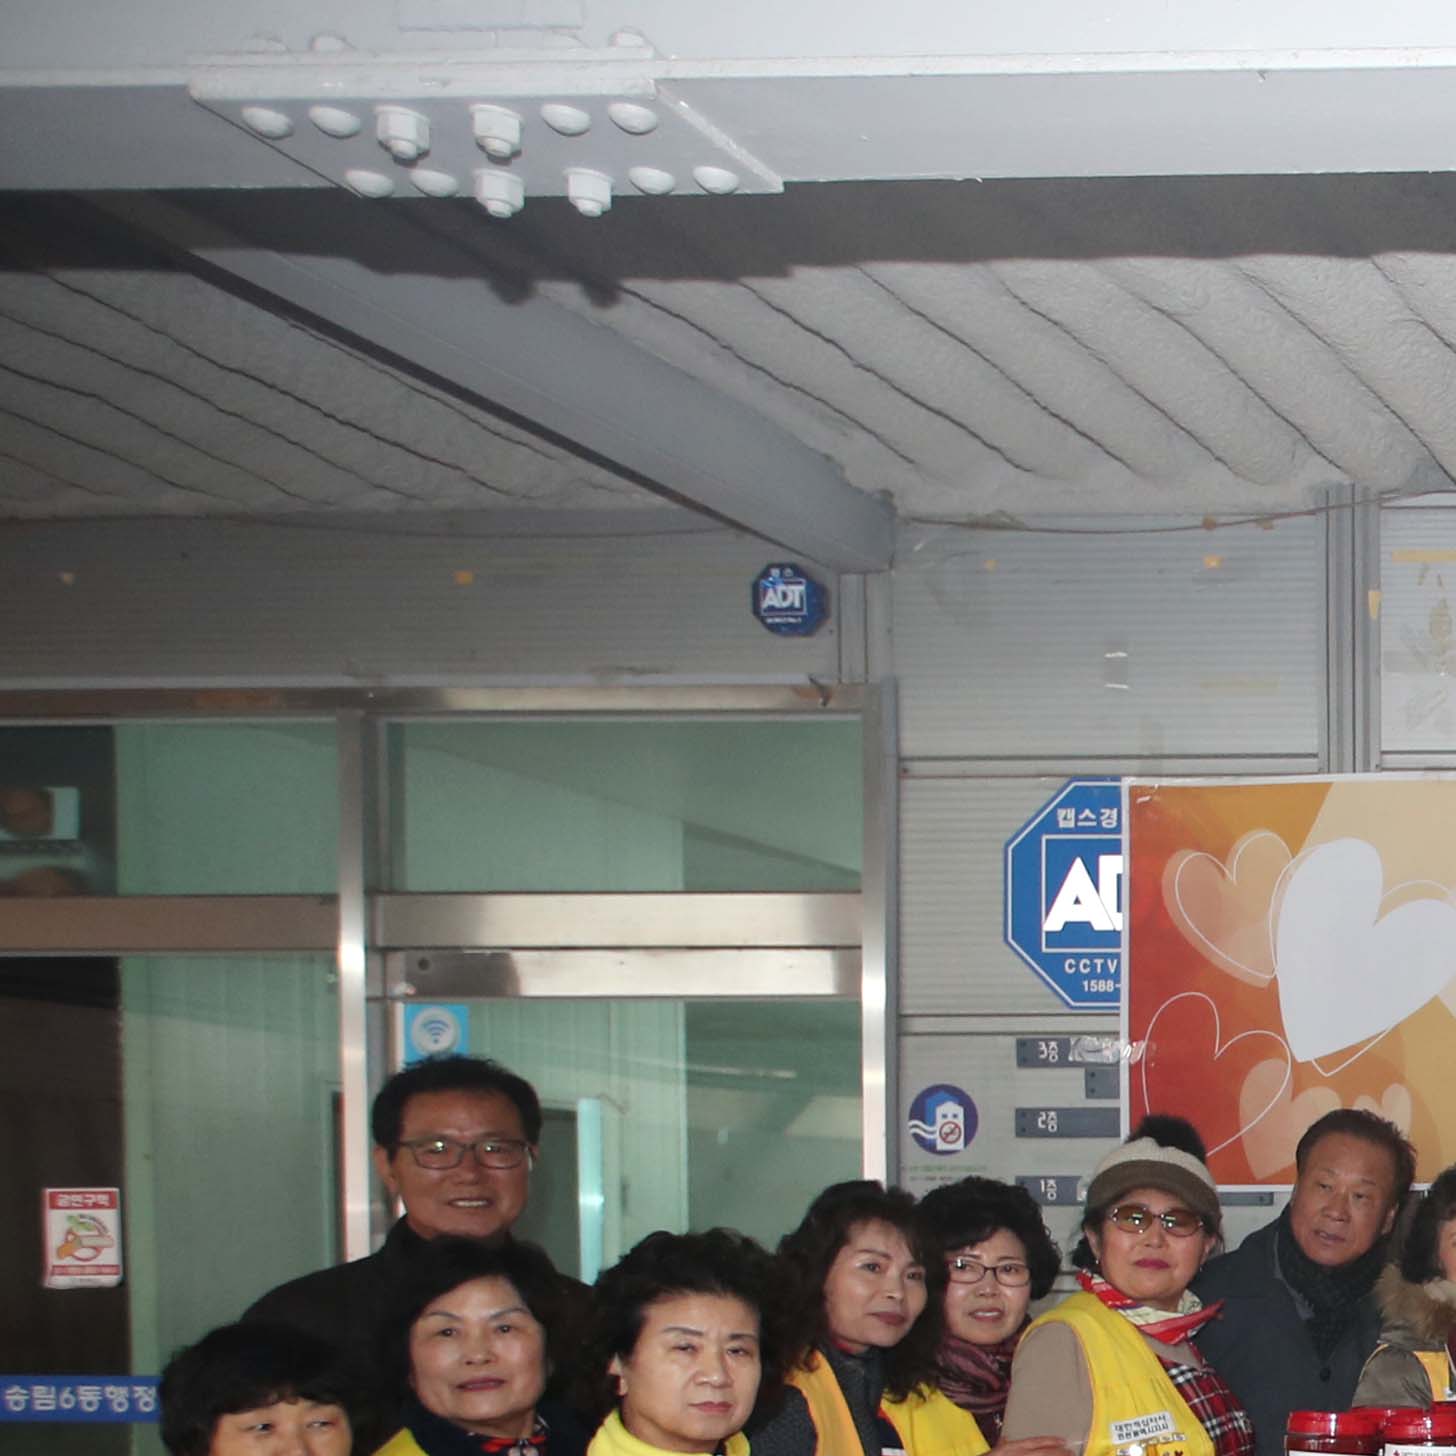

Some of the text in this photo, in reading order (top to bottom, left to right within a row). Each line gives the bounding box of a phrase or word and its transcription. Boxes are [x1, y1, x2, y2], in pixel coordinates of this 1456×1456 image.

[761, 585, 805, 608] ADT
[1064, 959, 1119, 974] CCTV
[1039, 1041, 1058, 1063] 3층
[1038, 1111, 1057, 1133] 2층
[1040, 1179, 1057, 1200] 1층
